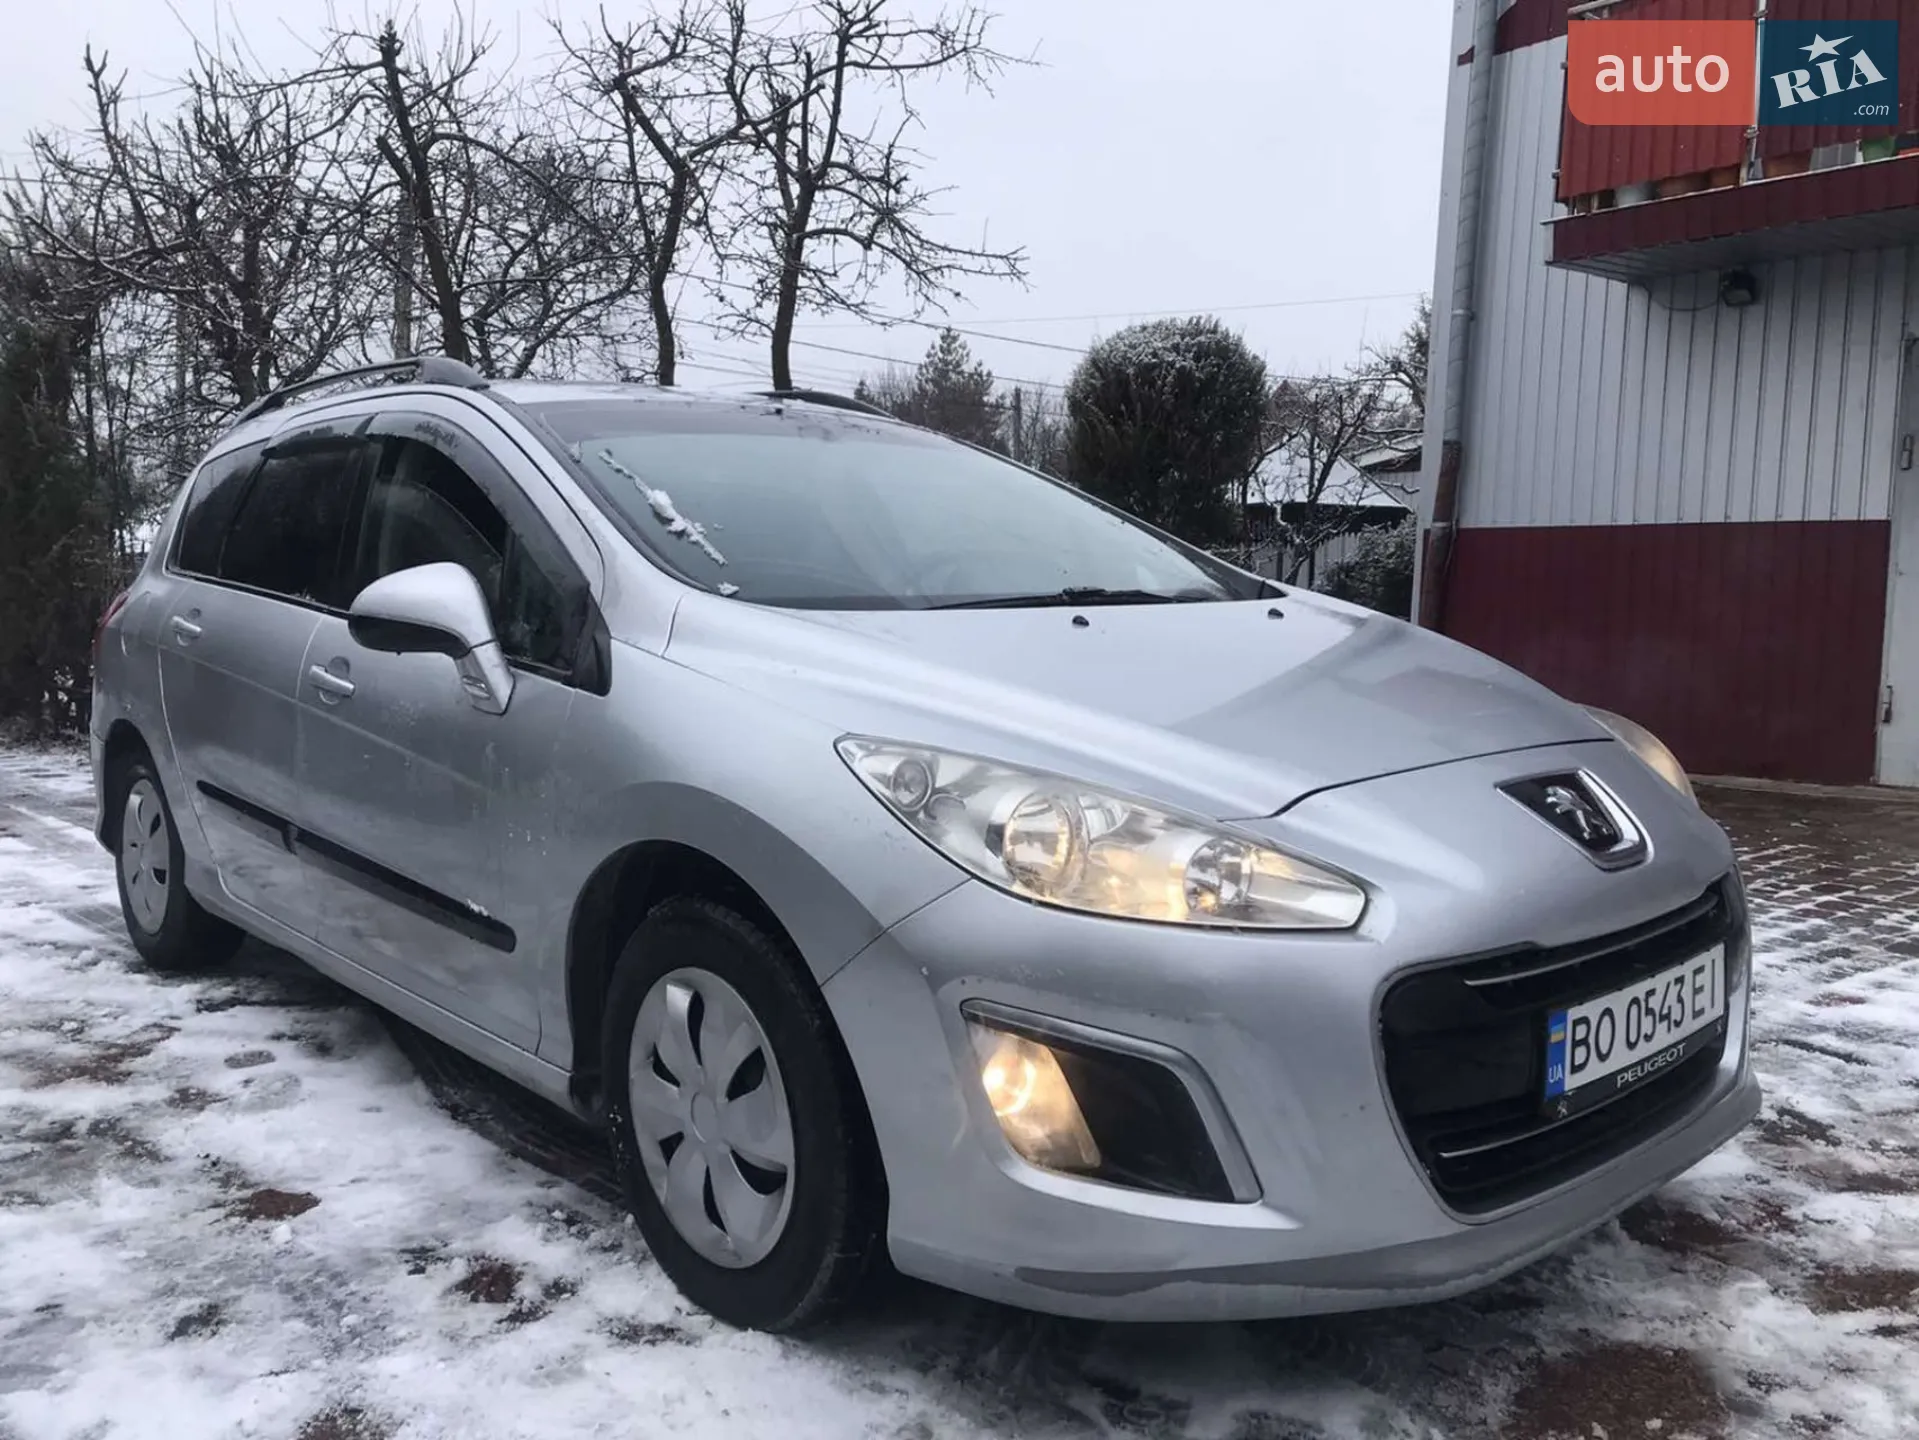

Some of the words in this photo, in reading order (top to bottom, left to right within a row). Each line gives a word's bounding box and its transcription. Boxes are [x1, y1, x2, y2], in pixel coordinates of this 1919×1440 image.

[1570, 1006, 1616, 1076] BO
[1625, 974, 1686, 1051] 0543
[1691, 958, 1716, 1021] EI
[1549, 1067, 1564, 1083] UA
[1616, 1042, 1687, 1088] PEUGEOT
